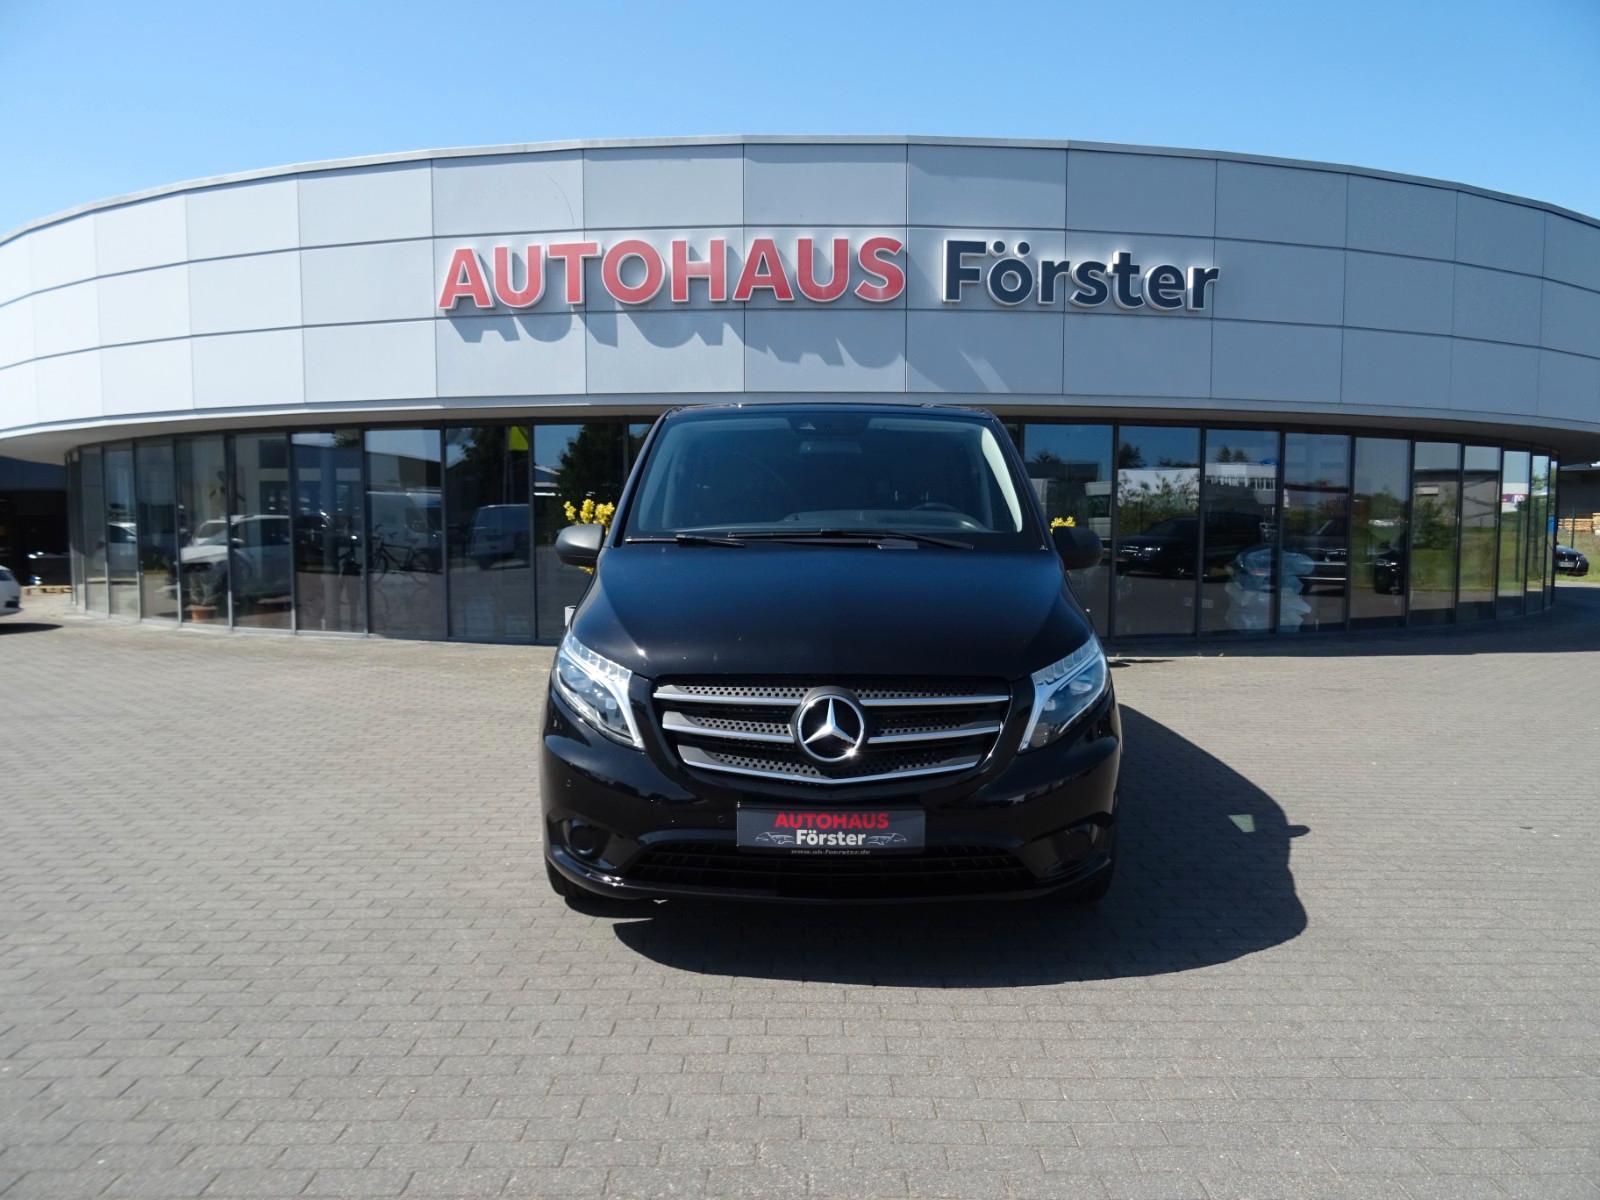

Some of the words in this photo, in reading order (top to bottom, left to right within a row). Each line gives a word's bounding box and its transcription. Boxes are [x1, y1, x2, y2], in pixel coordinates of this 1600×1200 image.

[438, 237, 906, 309] AUTOHAUS
[942, 238, 1220, 311] Förster
[774, 812, 890, 829] AUTOHAUS
[795, 829, 867, 846] Förster
